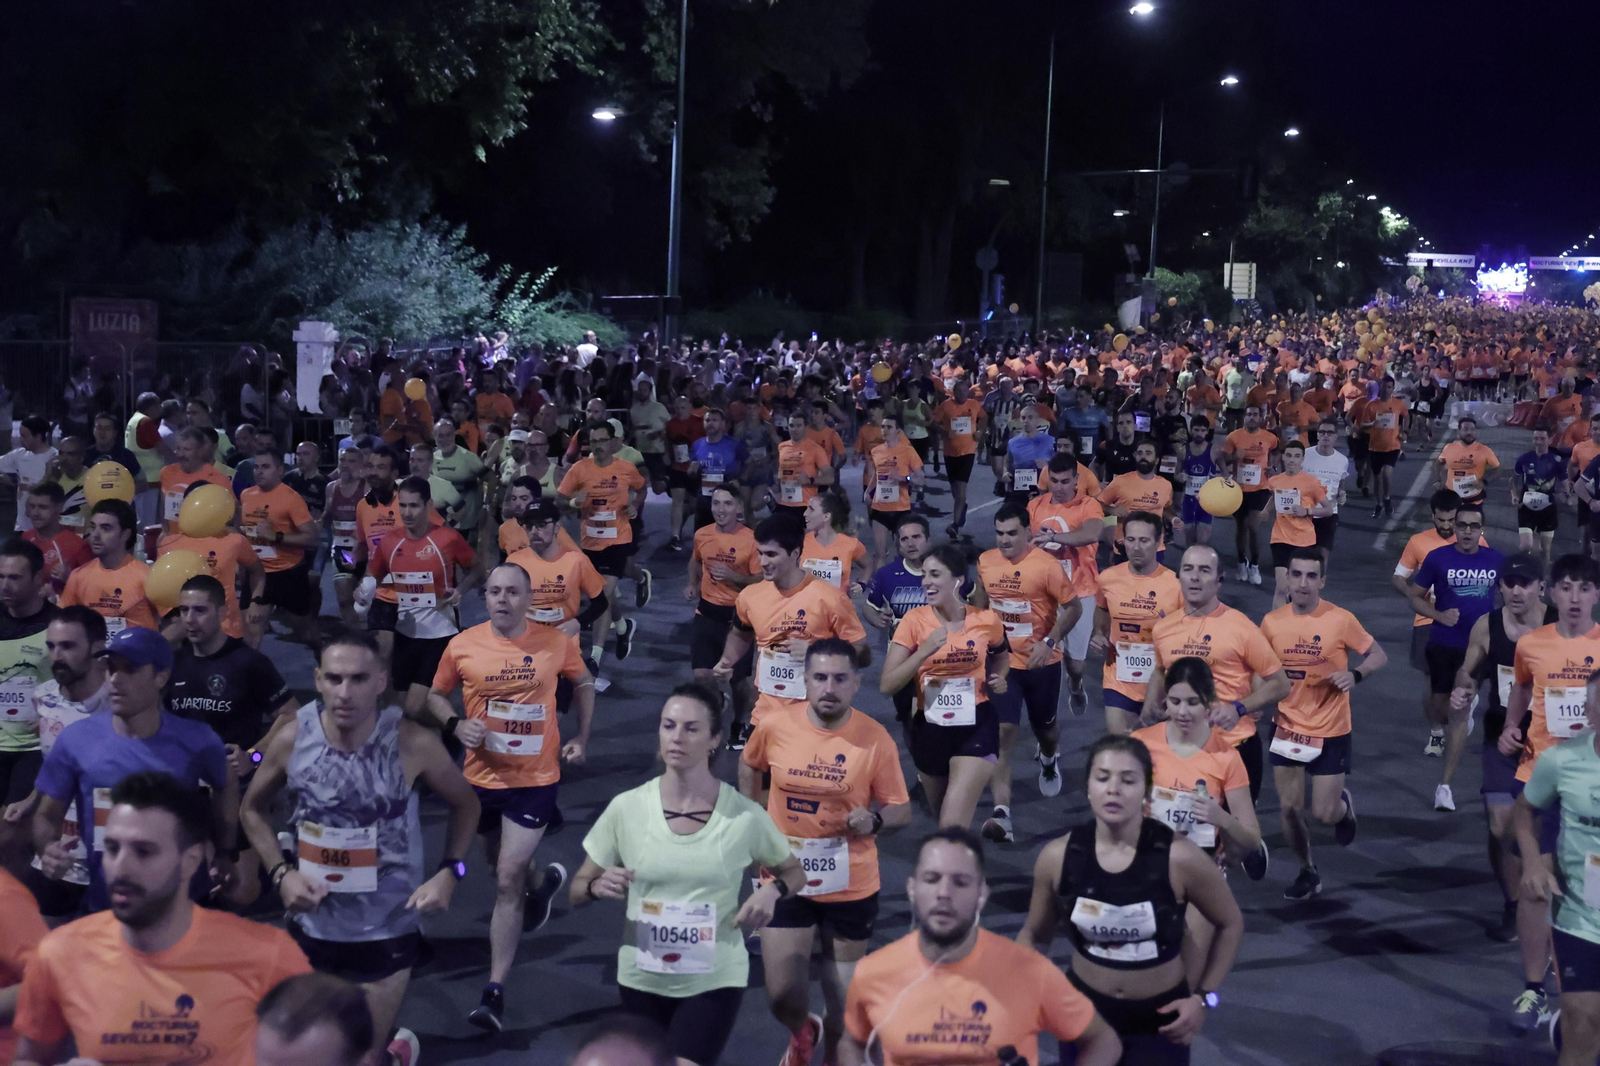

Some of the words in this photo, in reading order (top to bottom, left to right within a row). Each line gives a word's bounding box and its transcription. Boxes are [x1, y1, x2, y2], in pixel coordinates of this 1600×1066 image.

[89, 312, 140, 333] LUZIA
[812, 569, 832, 580] 9934
[1447, 569, 1496, 579] BONAO
[405, 584, 424, 593] 1189
[1001, 613, 1020, 622] 1286
[1125, 656, 1152, 667] 10090
[770, 666, 794, 680] 8036
[181, 698, 232, 712] JARTIBLES
[938, 694, 962, 706] 8038
[504, 721, 532, 734] 1219
[1290, 732, 1311, 745] 1469
[788, 768, 823, 780] SEVILLA
[824, 774, 845, 783] KH7
[807, 764, 847, 775] NOCTURNA
[321, 849, 350, 866] 946
[798, 858, 836, 872] 8628
[651, 926, 699, 944] 10548
[132, 1021, 199, 1032] NOCTURNA
[932, 1023, 992, 1032] NOCTURNA
[102, 1033, 160, 1044] SEVILLA
[164, 1032, 198, 1045] KH7
[906, 1034, 957, 1044] SEVILLA
[960, 1034, 990, 1045] KH7
